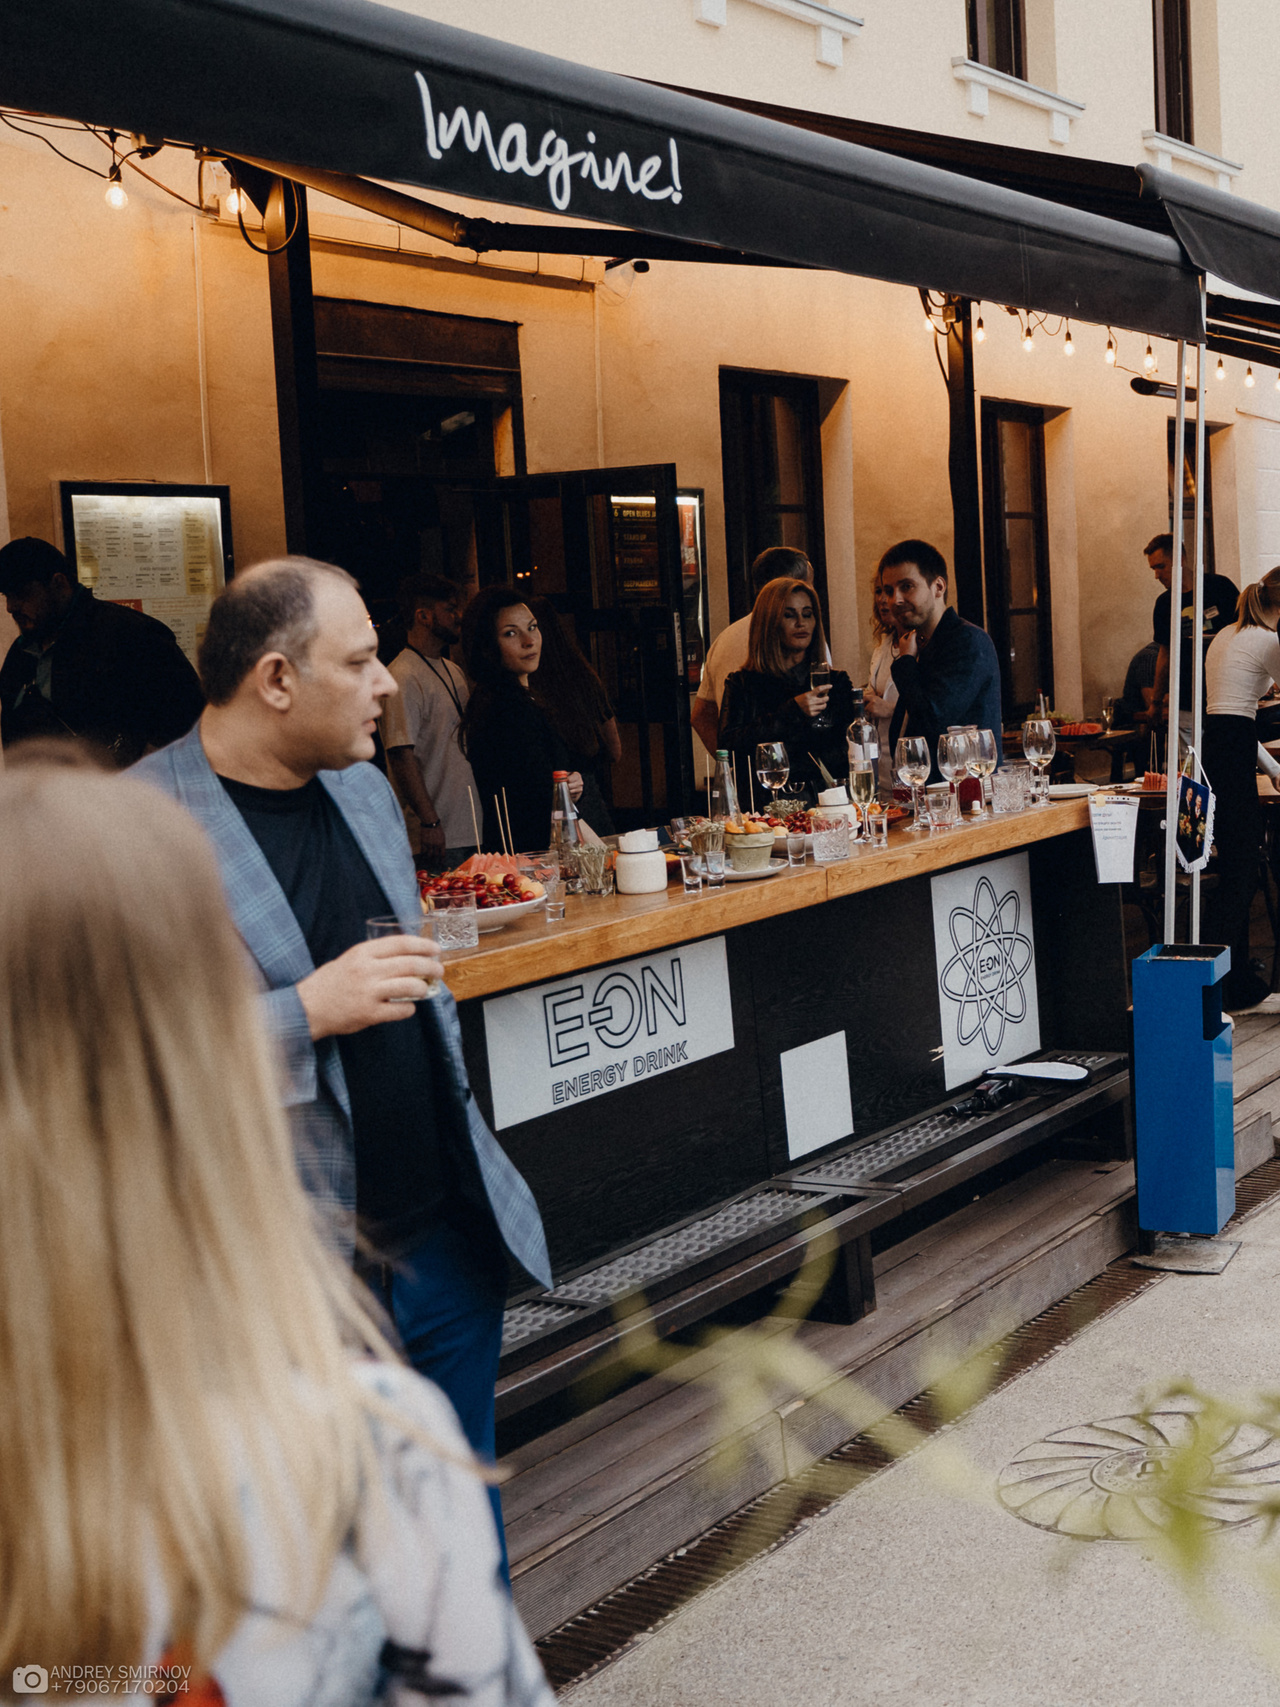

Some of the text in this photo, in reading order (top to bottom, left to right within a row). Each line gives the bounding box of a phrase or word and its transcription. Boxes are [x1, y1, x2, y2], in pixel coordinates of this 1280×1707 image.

[414, 70, 683, 211] Imagine!
[552, 1040, 689, 1105] ENERGY DRINK
